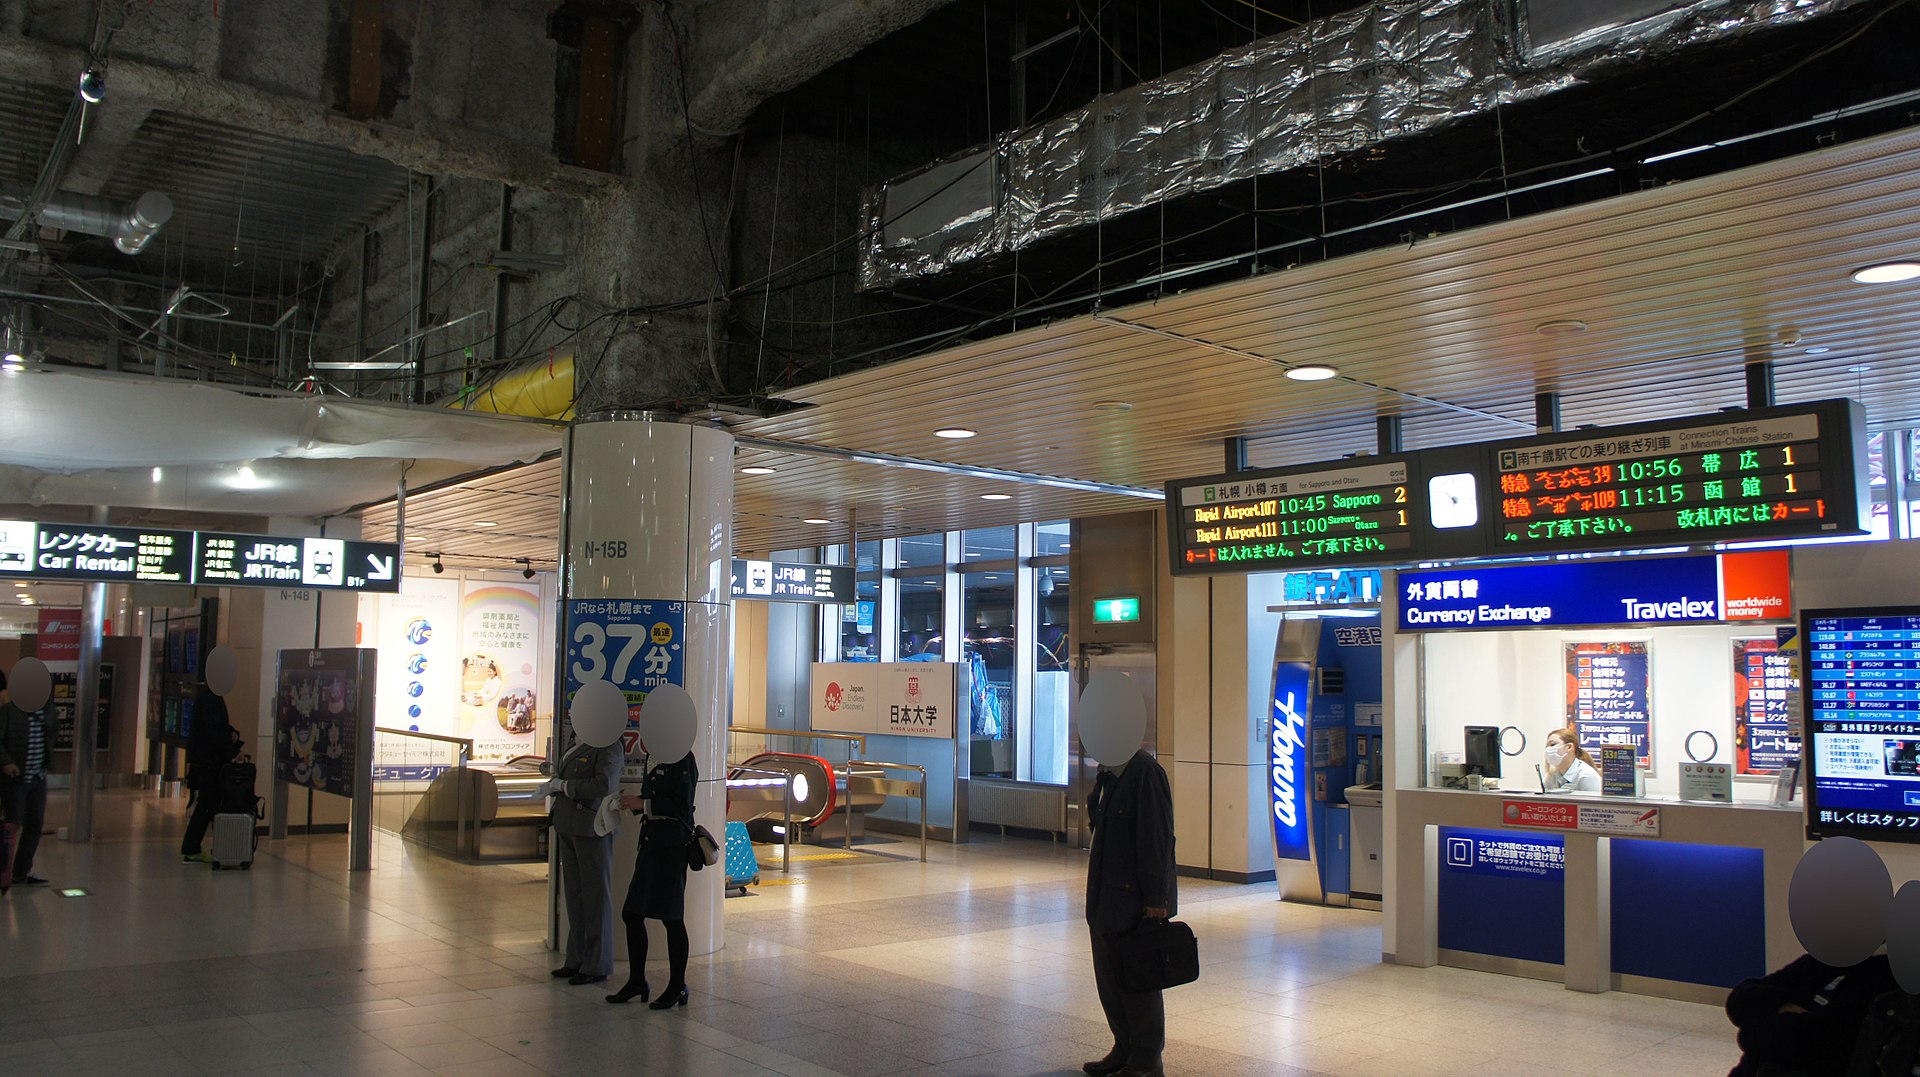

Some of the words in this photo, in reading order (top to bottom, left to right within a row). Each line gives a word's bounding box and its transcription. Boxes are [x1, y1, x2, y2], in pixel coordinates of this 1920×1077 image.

[1679, 430, 1728, 442] Connection
[1731, 426, 1758, 436] Trains
[1691, 434, 1760, 450] Minami-Chitose
[1762, 432, 1794, 443] Station
[1518, 436, 1670, 466] 南千歳駅での乗り継ぎ列車
[1501, 474, 1530, 494] 特急
[1617, 458, 1682, 482] 10:56
[1782, 446, 1795, 466] 1
[1220, 484, 1240, 498] 札幌
[1245, 482, 1267, 496] 小樽
[1270, 482, 1288, 495] 方面
[1308, 479, 1330, 490] Sapporo
[1343, 476, 1359, 484] Otaru
[1279, 495, 1326, 516] 10:45
[1332, 492, 1380, 510] Sapporo
[1394, 486, 1406, 504] 2
[1503, 498, 1532, 518] 特急
[1619, 484, 1684, 508] 11:15
[1784, 474, 1796, 494] 1
[1280, 518, 1327, 536] 11:00
[1355, 519, 1378, 530] Otaru
[1397, 510, 1407, 526] 1
[39, 531, 136, 553] レンタカー
[585, 540, 628, 558] N-15B
[244, 542, 298, 563] JR線
[38, 554, 72, 569] Car
[76, 555, 134, 572] Rental
[244, 564, 262, 580] JR
[262, 564, 300, 580] Train
[774, 567, 806, 582] JR線
[347, 576, 366, 587] B1F
[774, 583, 787, 594] JR
[788, 583, 812, 596] Train
[1406, 579, 1478, 600] 外貨両替
[574, 602, 652, 615] JRなら札幌まで
[668, 602, 682, 612] JR
[1622, 597, 1715, 619] Travelex
[1726, 597, 1782, 608] worldwide
[1407, 607, 1474, 625] Currency
[1478, 605, 1551, 622] Exchange
[1726, 606, 1764, 618] money
[653, 627, 670, 637] 最速
[572, 622, 646, 685] 37
[644, 646, 672, 674] 分
[644, 675, 668, 686] min
[1593, 700, 1634, 710] タイバーツ
[890, 705, 937, 726] 日本大学
[1521, 812, 1573, 823] 買い取りいたします
[1526, 806, 1566, 814] ユーロコインの
[1820, 810, 1920, 828] 詳しくはスタッフ
[1496, 865, 1547, 875] www.travelex.co.jp
